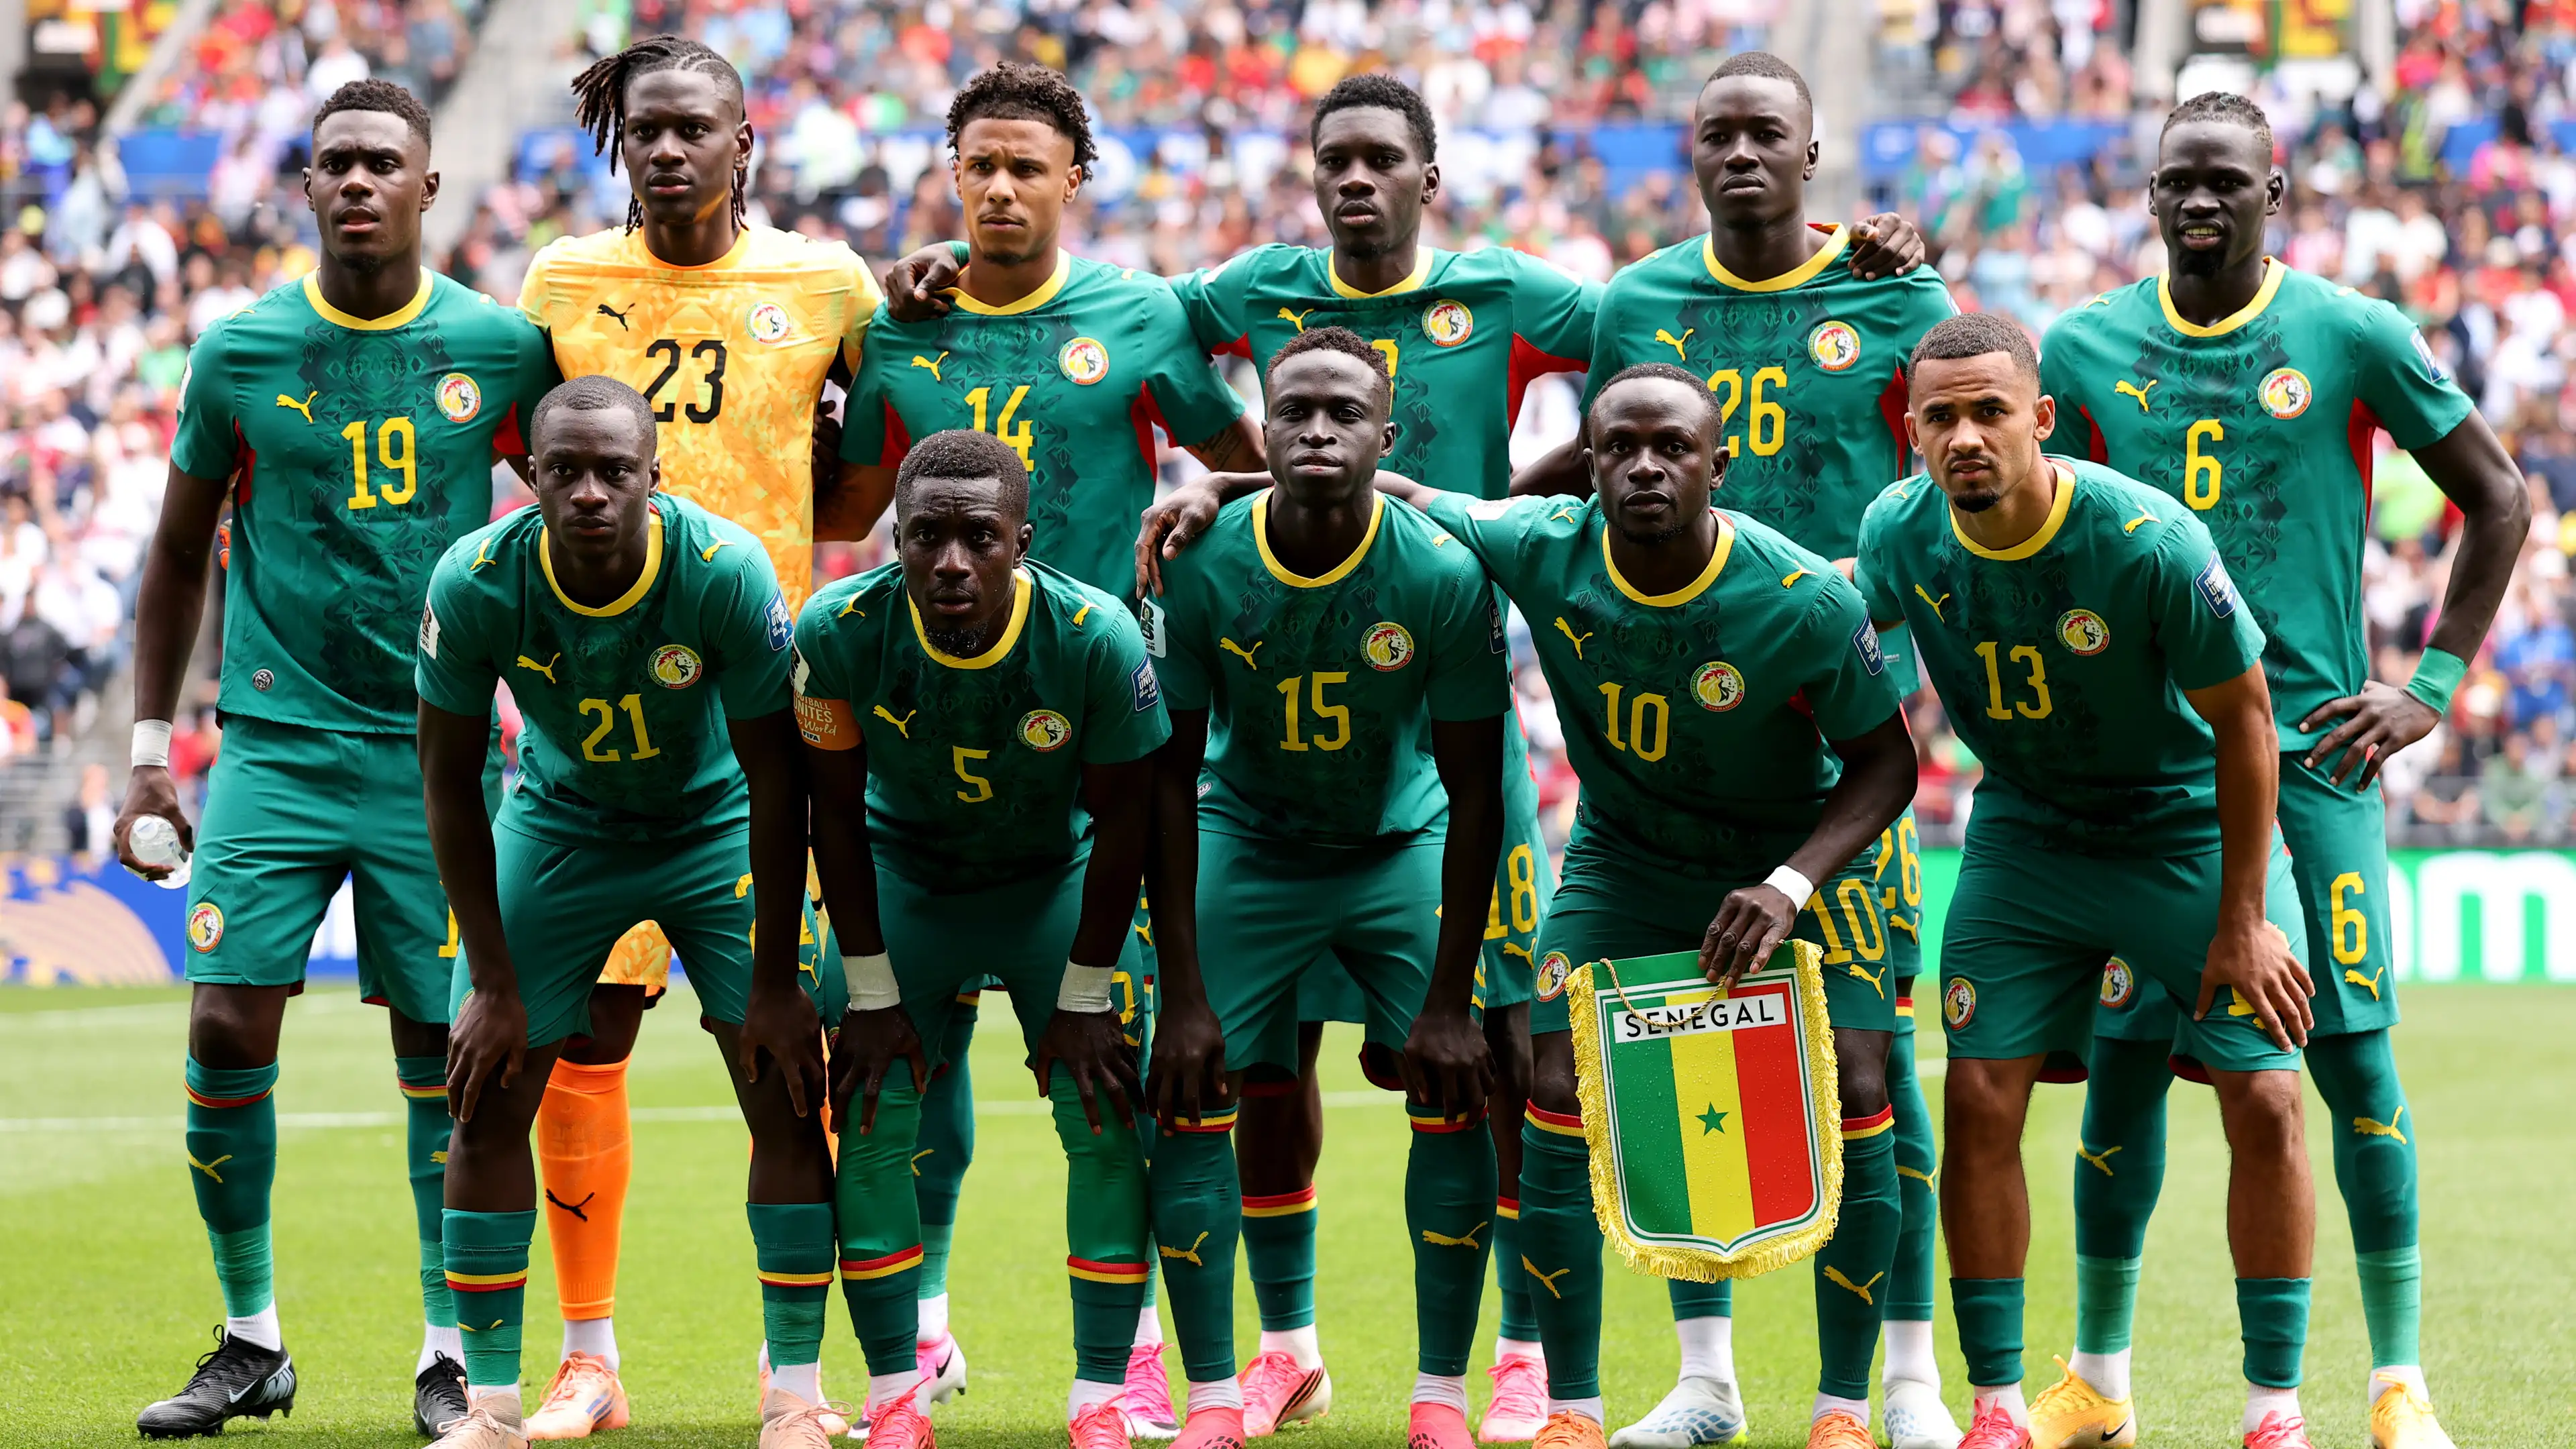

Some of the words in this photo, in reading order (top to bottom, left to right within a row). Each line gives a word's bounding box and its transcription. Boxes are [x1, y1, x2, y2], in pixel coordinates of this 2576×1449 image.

[643, 339, 727, 424] 23
[1707, 366, 1788, 458] 26
[341, 417, 417, 510] 19
[964, 385, 1034, 472] 14
[2184, 419, 2224, 511] 6
[794, 696, 833, 722] UNITES
[1277, 672, 1351, 751] 15
[1974, 641, 2053, 720] 13
[579, 693, 661, 762] 21
[802, 730, 820, 742] FIFA
[804, 717, 837, 736] World
[1599, 682, 1669, 762] 10
[953, 747, 993, 802] 5
[1483, 843, 1538, 940] 18
[1874, 818, 1921, 909] 26
[1803, 879, 1885, 965] 10
[2330, 871, 2367, 965] 6
[1625, 1000, 1774, 1037] SENEGAL
